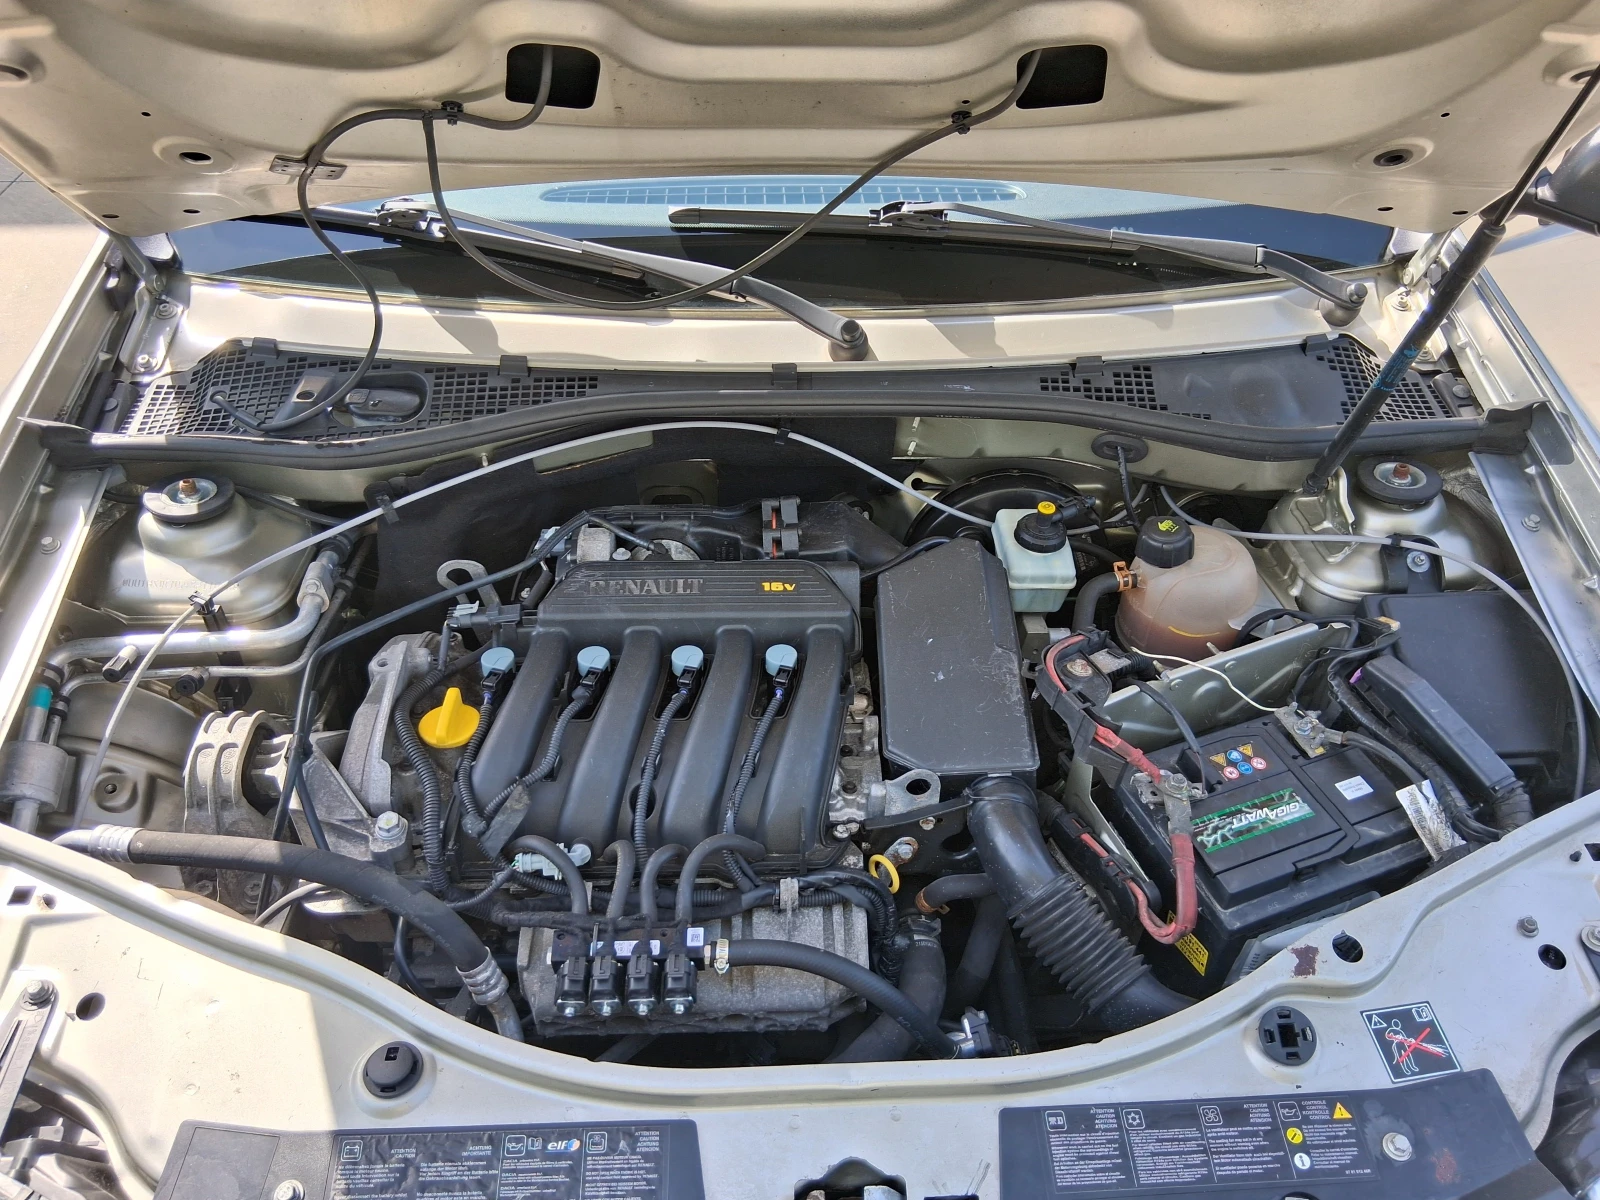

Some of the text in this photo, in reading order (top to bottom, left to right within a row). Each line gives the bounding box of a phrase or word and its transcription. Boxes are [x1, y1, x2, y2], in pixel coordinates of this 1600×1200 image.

[587, 578, 704, 595] RENAULT
[1231, 802, 1300, 829] GIGAWATT
[547, 1140, 568, 1150] elf
